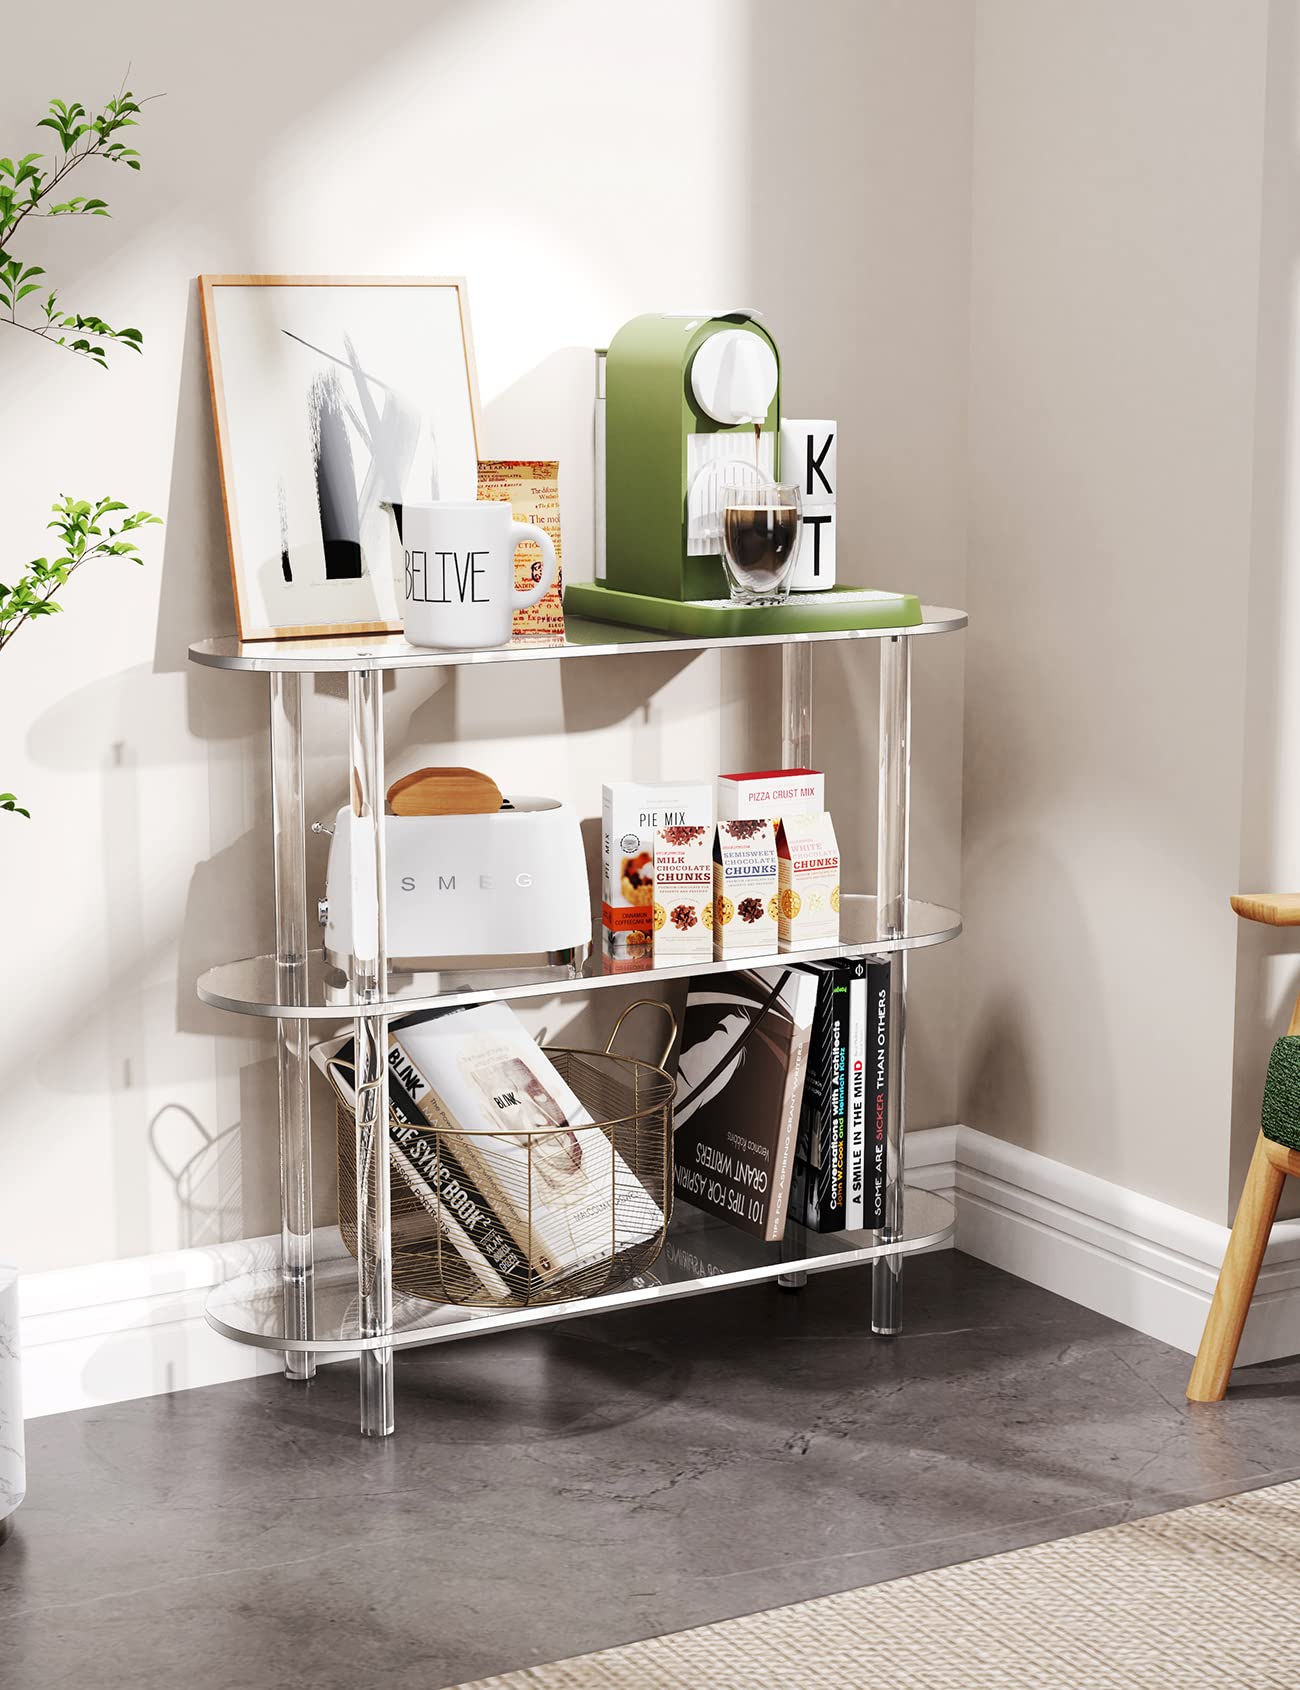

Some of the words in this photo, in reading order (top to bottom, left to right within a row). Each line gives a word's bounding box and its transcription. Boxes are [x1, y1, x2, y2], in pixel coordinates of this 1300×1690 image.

[806, 434, 834, 495] K
[528, 514, 545, 524] The
[803, 515, 832, 576] T
[405, 549, 490, 603] BELIVE
[748, 791, 770, 801] PIZZA
[772, 789, 798, 800] CRUST
[800, 787, 815, 797] MIX
[639, 812, 658, 827] PIE
[664, 811, 686, 826] MIX
[724, 850, 775, 858] SEMISWEET
[725, 857, 776, 865] CHOCOLATE
[793, 857, 838, 869] CHUNKS
[400, 872, 533, 892] SMEG
[656, 873, 711, 881] CHUNKS
[725, 865, 776, 875] CHUNKS
[877, 989, 886, 1046] OTHERS
[832, 1020, 840, 1085] Architects
[388, 1048, 424, 1100] BLINK
[853, 1060, 863, 1097] MIND
[877, 1049, 885, 1089] THAN
[429, 1098, 441, 1111] The
[493, 1092, 522, 1109] BLINK
[853, 1102, 862, 1127] THE
[876, 1093, 884, 1141] SICKER
[853, 1131, 862, 1146] IN
[410, 1139, 452, 1187] SYNC
[695, 1142, 732, 1178] WRITERS
[772, 1217, 780, 1239] TIPS
[780, 1136, 790, 1189] ASPIRING
[787, 1093, 796, 1133] GRANT
[830, 1118, 838, 1210] Conversations
[852, 1150, 862, 1192] SMILE
[875, 1144, 883, 1172] ARE
[674, 1163, 707, 1196] ASPIRIN
[733, 1160, 768, 1193] GRANT
[707, 1179, 727, 1206] FOR
[727, 1189, 745, 1216] TIPS
[852, 1194, 861, 1204] A
[874, 1177, 882, 1216] SOME
[747, 1198, 764, 1225] 101
